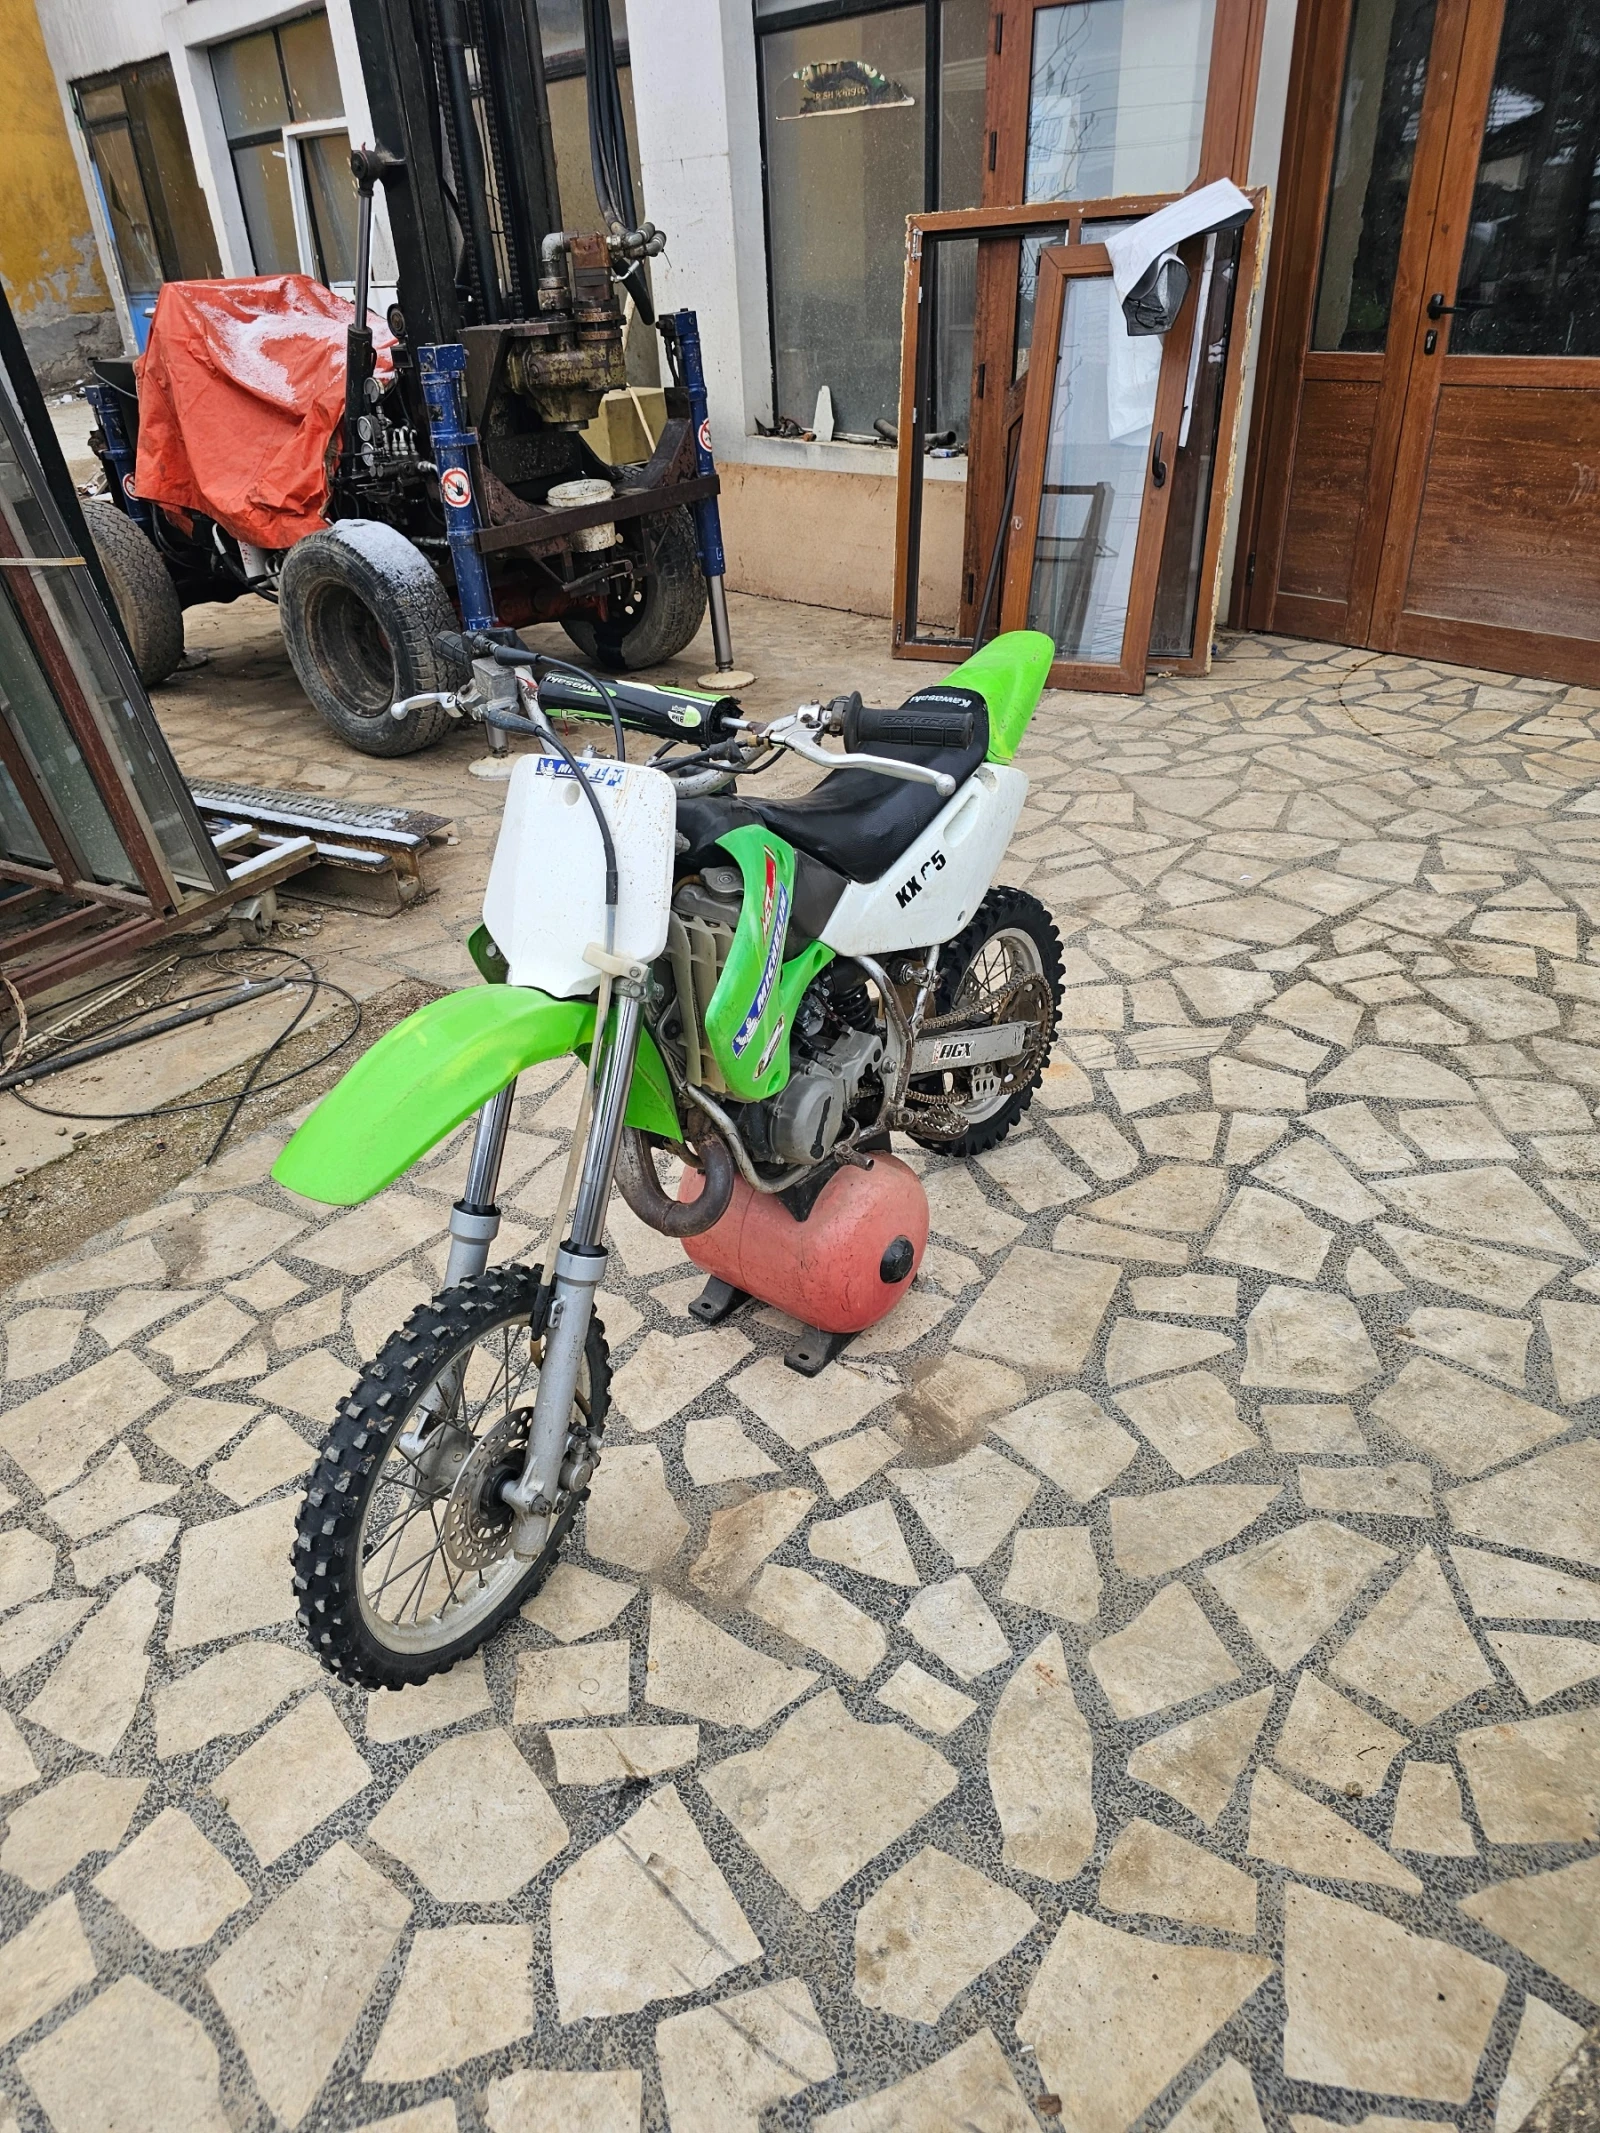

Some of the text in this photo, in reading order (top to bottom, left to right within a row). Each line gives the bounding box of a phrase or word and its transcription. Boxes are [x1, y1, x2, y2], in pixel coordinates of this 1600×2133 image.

[545, 675, 599, 693] awasaki
[908, 695, 973, 708] Kawasaki
[881, 715, 962, 726] PROGRIP
[895, 876, 922, 909] KX
[756, 892, 787, 1012] MICHELIN
